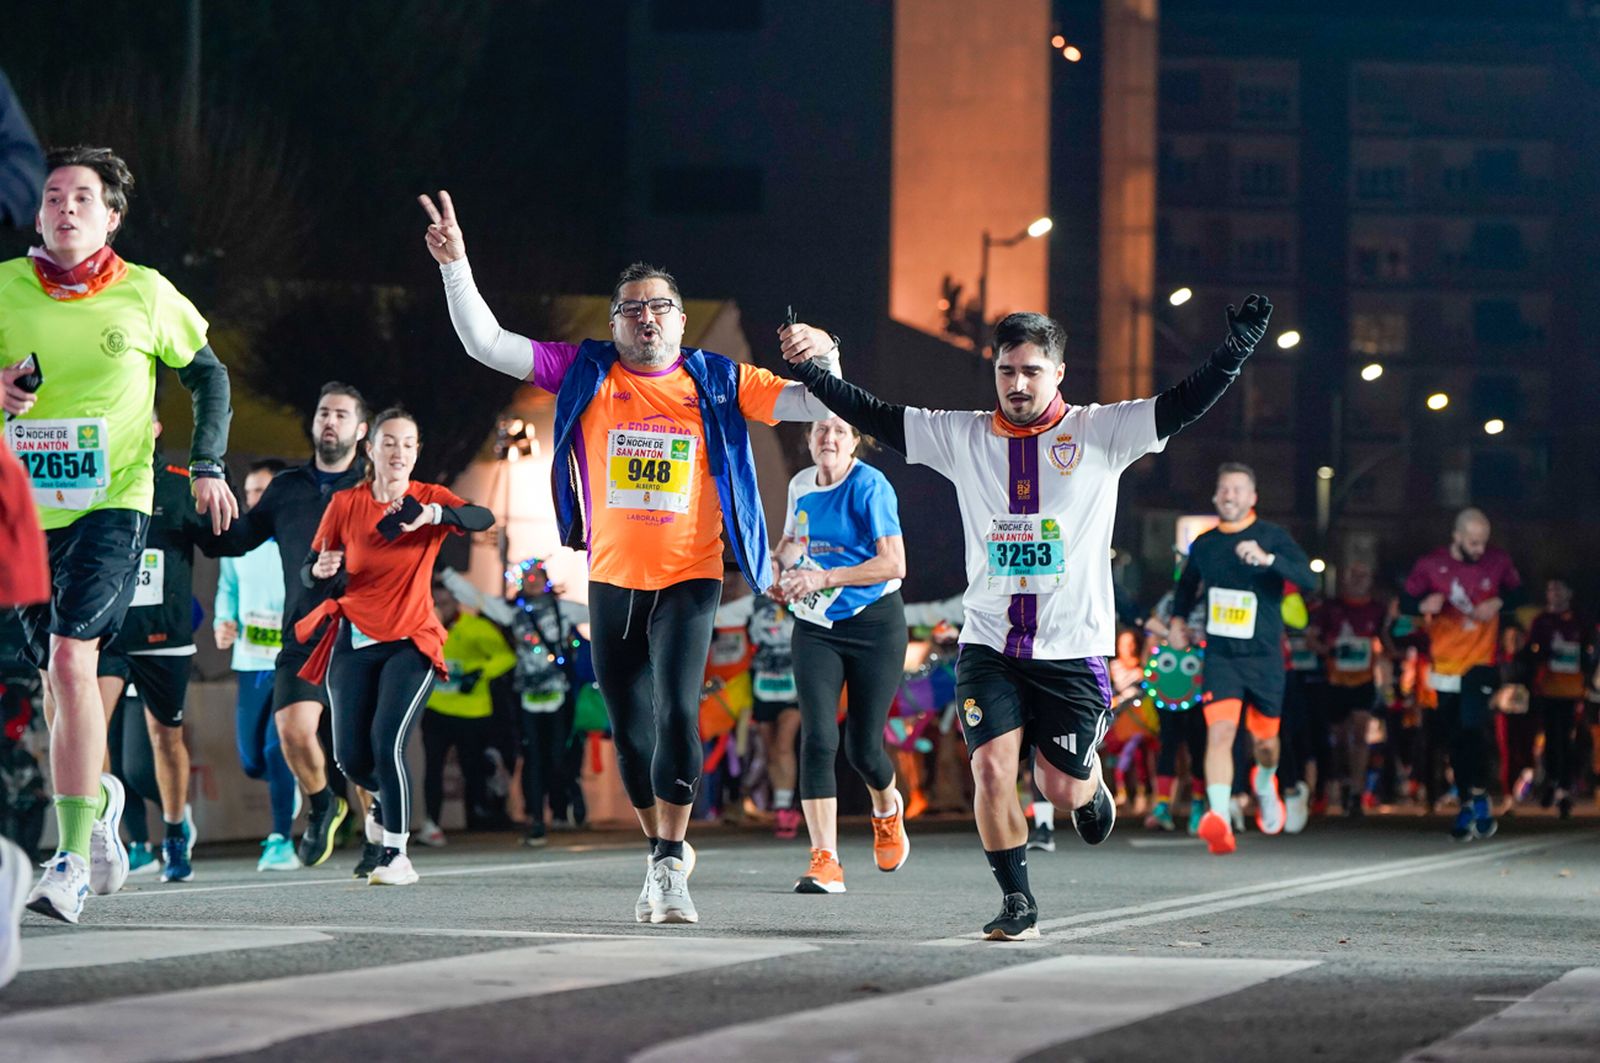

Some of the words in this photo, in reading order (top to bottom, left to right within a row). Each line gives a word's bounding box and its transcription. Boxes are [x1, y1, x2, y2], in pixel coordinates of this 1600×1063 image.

[26, 430, 54, 439] NOCHE
[57, 430, 68, 439] DE
[16, 441, 34, 450] SAN
[37, 438, 69, 450] ANTÓN
[626, 439, 651, 448] NOCHE
[653, 441, 664, 449] DE
[616, 447, 633, 456] SAN
[634, 447, 663, 459] ANTÓN
[19, 452, 97, 479] 12654
[628, 459, 671, 483] 948
[627, 514, 660, 522] LABORAL
[998, 523, 1022, 531] NOCHE
[1023, 523, 1033, 531] DE
[991, 533, 1004, 541] SAN
[1006, 530, 1034, 541] ANTÓN
[996, 542, 1052, 567] 3253
